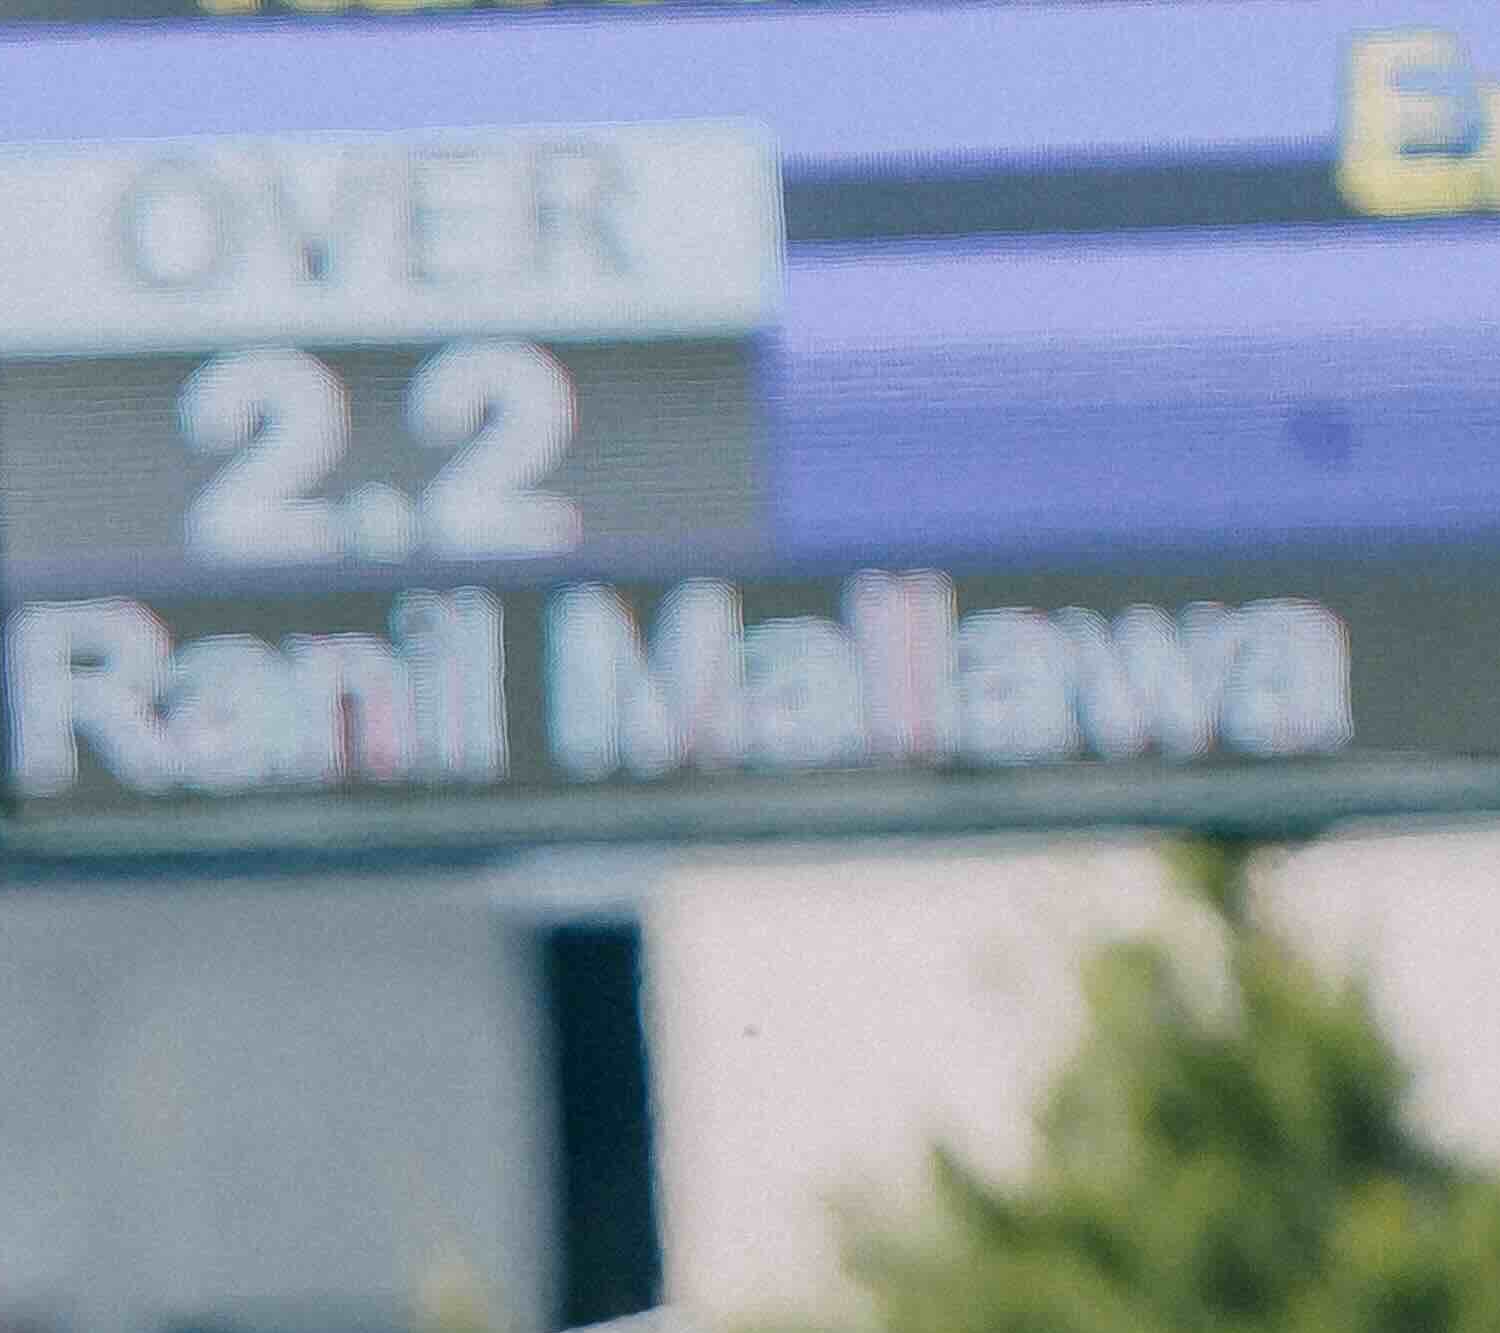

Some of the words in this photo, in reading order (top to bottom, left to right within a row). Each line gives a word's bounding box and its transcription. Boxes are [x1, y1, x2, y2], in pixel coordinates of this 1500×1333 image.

[110, 140, 648, 294] OVER
[177, 338, 584, 567] 2.2
[2, 587, 510, 798] Ranil
[543, 567, 1355, 783] Mallawa
